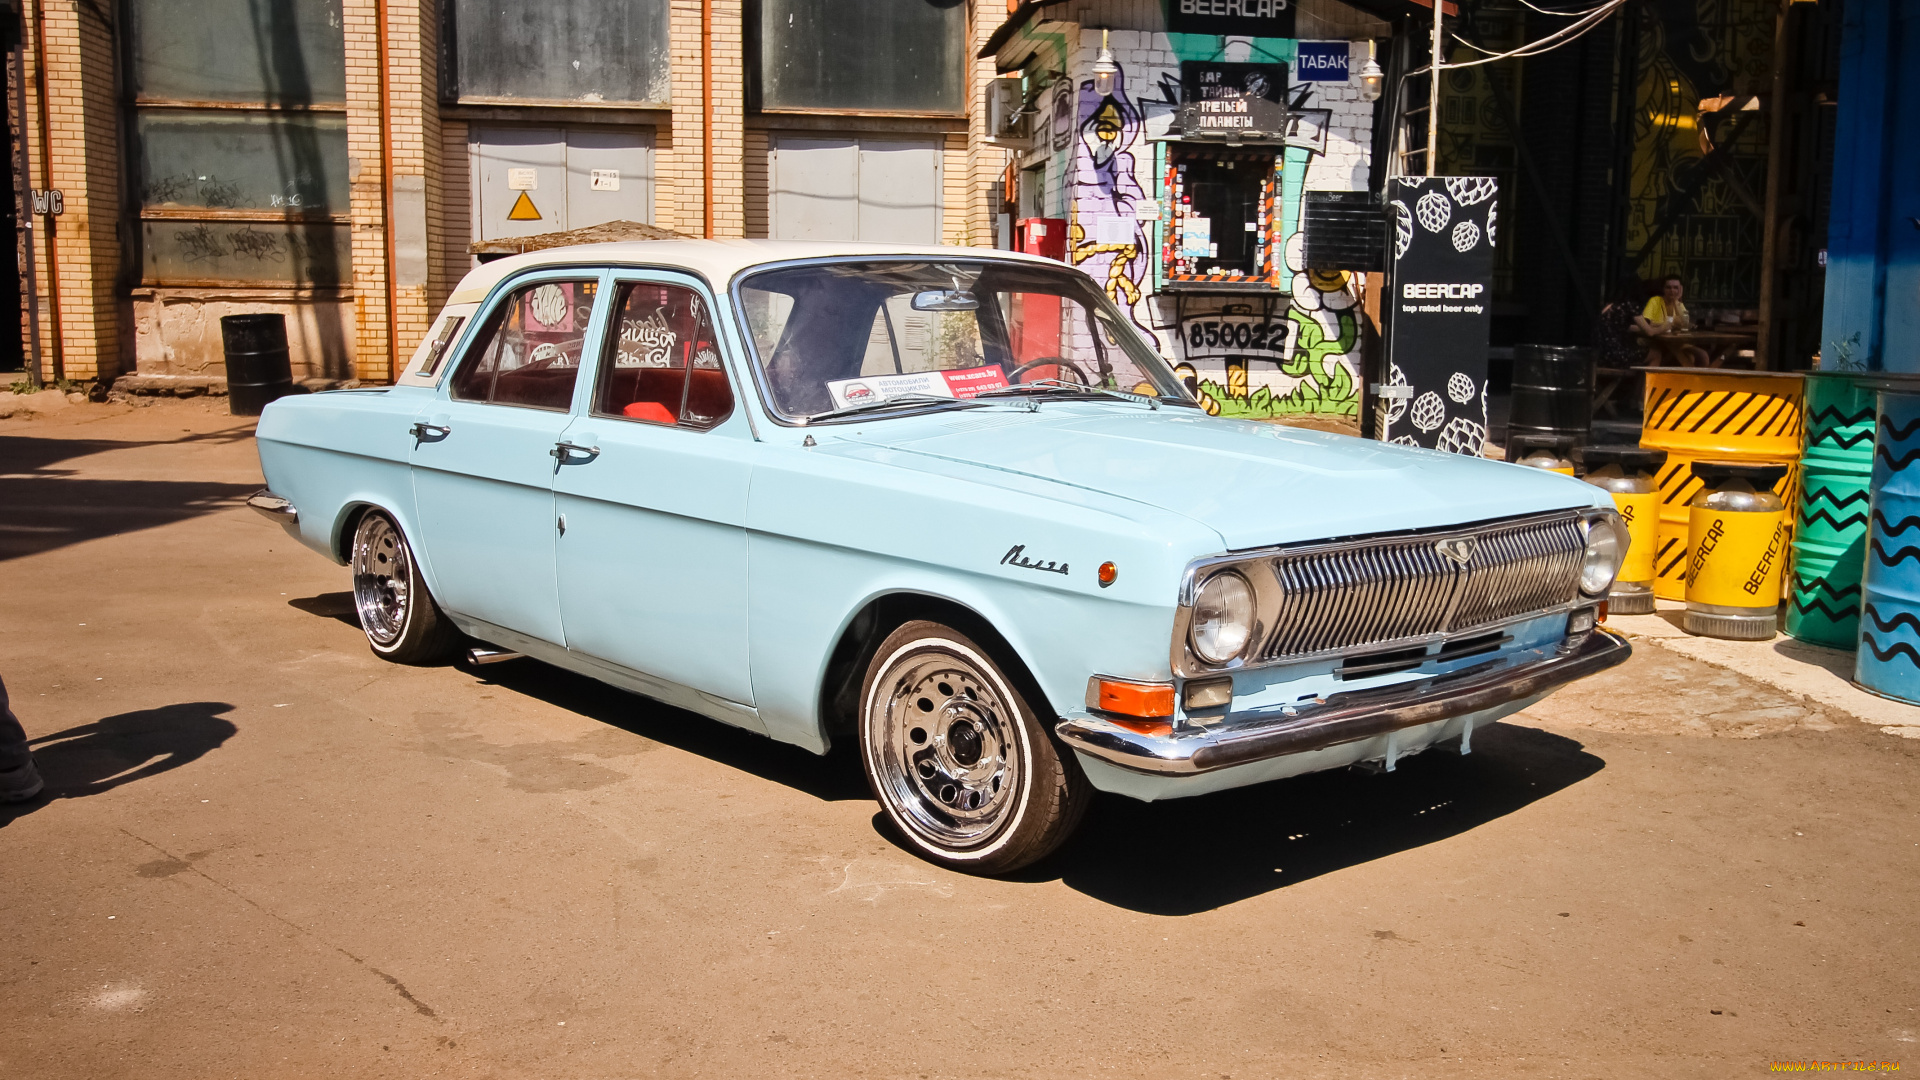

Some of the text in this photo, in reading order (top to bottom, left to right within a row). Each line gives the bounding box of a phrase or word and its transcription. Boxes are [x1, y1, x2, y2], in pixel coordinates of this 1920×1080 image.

[1180, 0, 1287, 18] BEERCAP
[1300, 55, 1348, 69] ТАБАК
[1200, 71, 1222, 83] БАР
[1200, 98, 1248, 113] ТРЕТЬЕЙ
[1200, 115, 1253, 128] ПЛАНЕТЫ
[31, 190, 63, 215] WC
[1403, 284, 1484, 298] BEERCAP
[1402, 304, 1417, 314] top
[1464, 305, 1483, 314] only
[1190, 322, 1289, 353] 850022
[878, 377, 930, 387] АВТОМОБИЛИ
[948, 369, 997, 381] www.xcars.by
[881, 384, 931, 394] МОТОЦИКЛЫ
[1686, 518, 1725, 588] BEERCAP
[1743, 520, 1783, 596] BEERCAP
